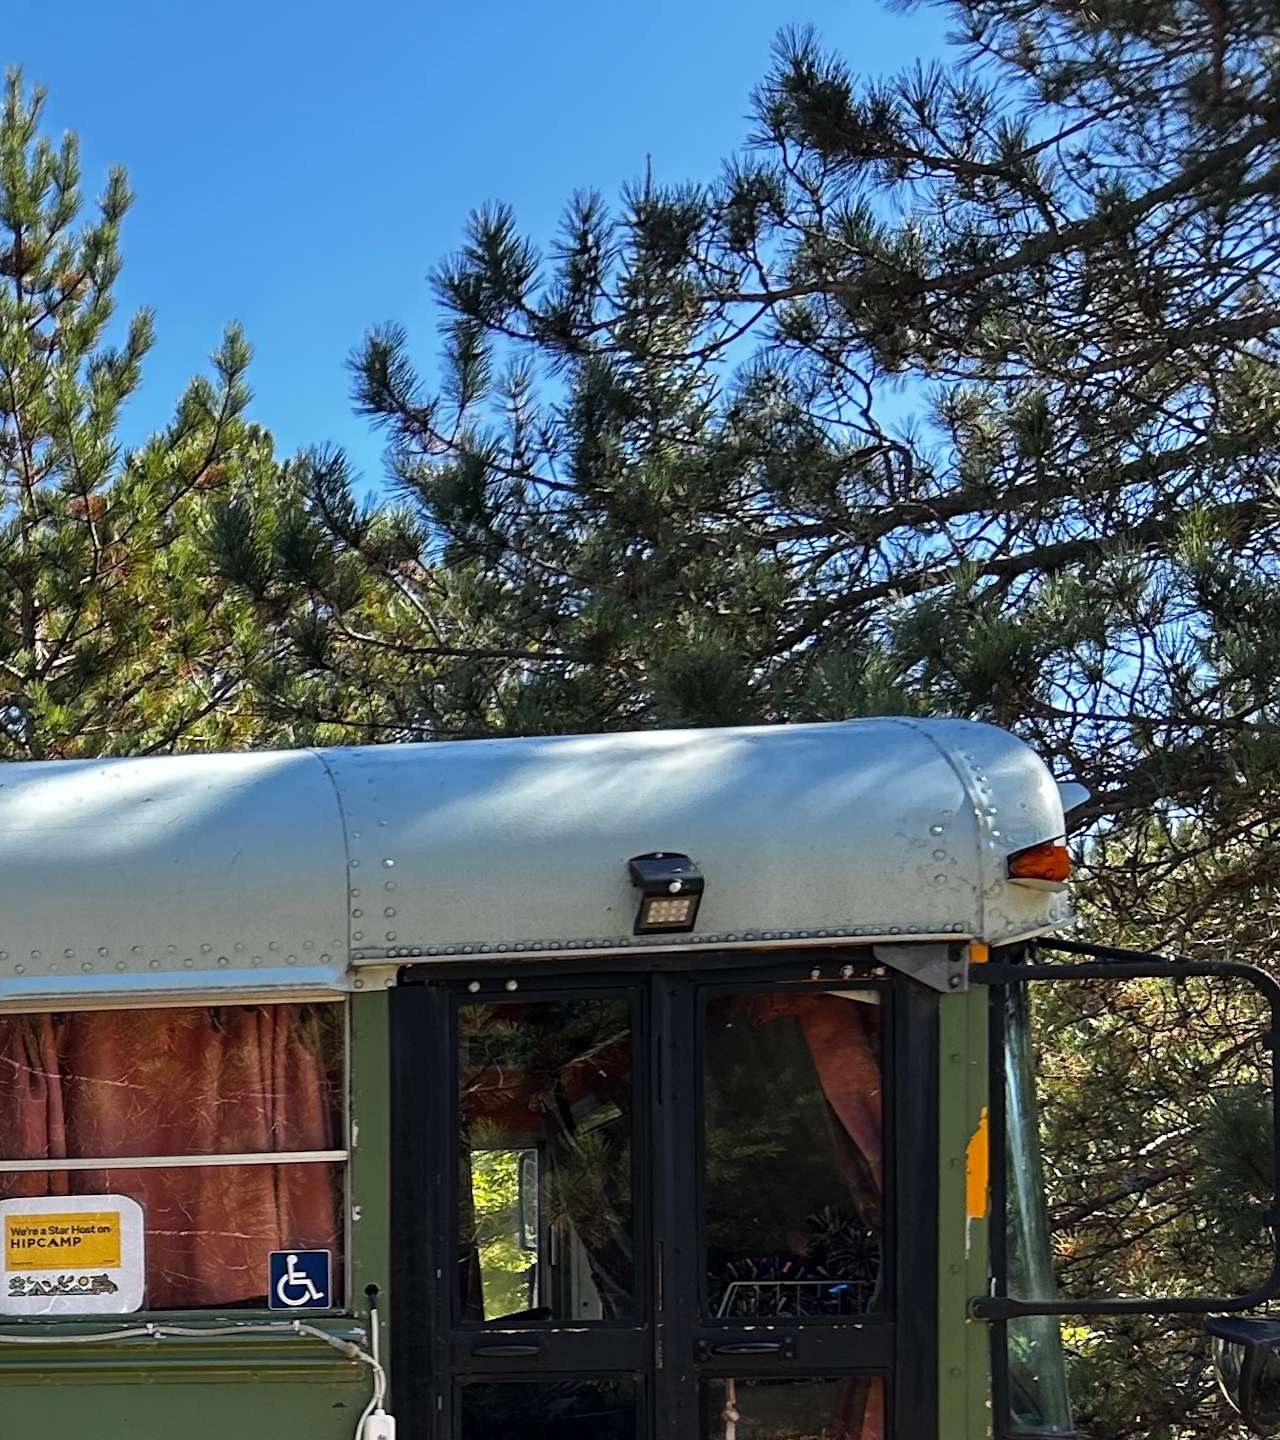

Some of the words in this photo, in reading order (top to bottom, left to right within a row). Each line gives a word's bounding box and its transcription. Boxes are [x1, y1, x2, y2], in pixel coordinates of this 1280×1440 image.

[10, 1226, 39, 1236] We're
[40, 1228, 47, 1236] a
[48, 1225, 70, 1236] Star
[71, 1225, 97, 1234] Host
[10, 1237, 82, 1249] HIPCAMP
